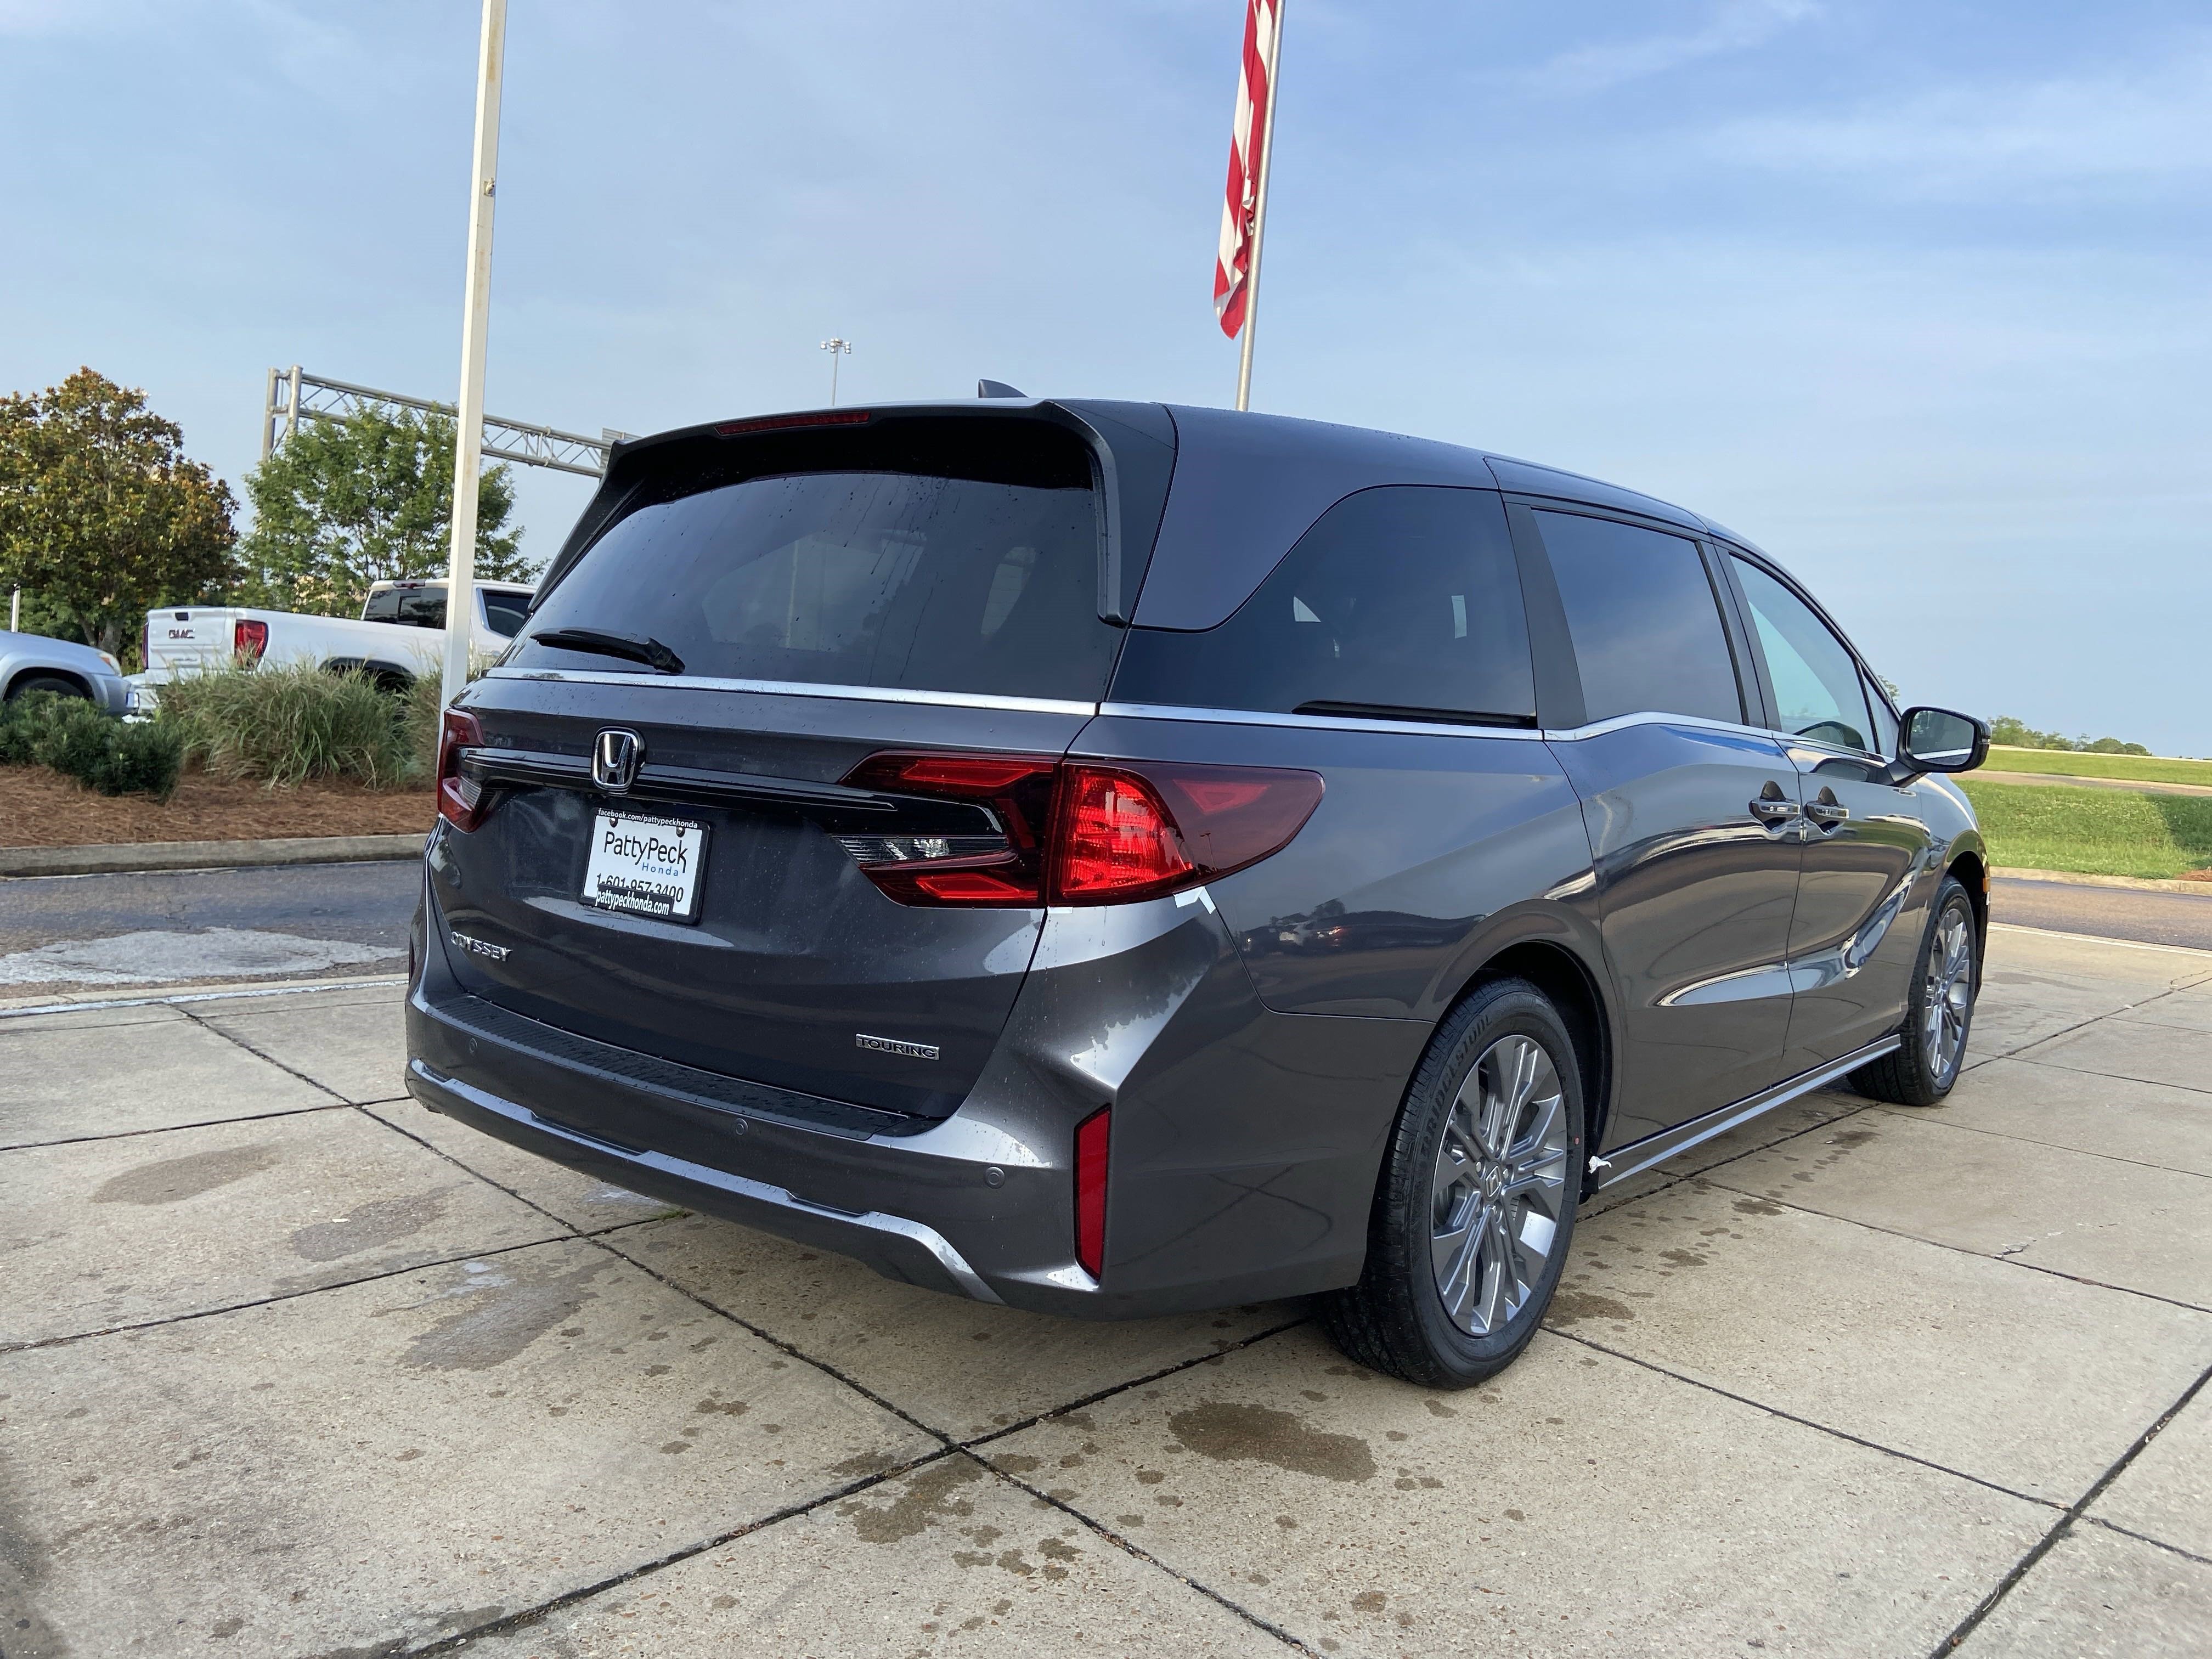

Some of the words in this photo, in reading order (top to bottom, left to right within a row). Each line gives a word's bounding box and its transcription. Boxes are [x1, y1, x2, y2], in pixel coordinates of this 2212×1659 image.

[169, 629, 195, 639] GMC
[598, 808, 698, 828] facebook.com/pattypeckhonda
[603, 831, 689, 873] PattyPeck
[641, 862, 679, 877] Honda
[595, 889, 669, 916] pattypeckhonda.com
[451, 931, 513, 962] ODYSSEY
[857, 1037, 935, 1058] TOURING
